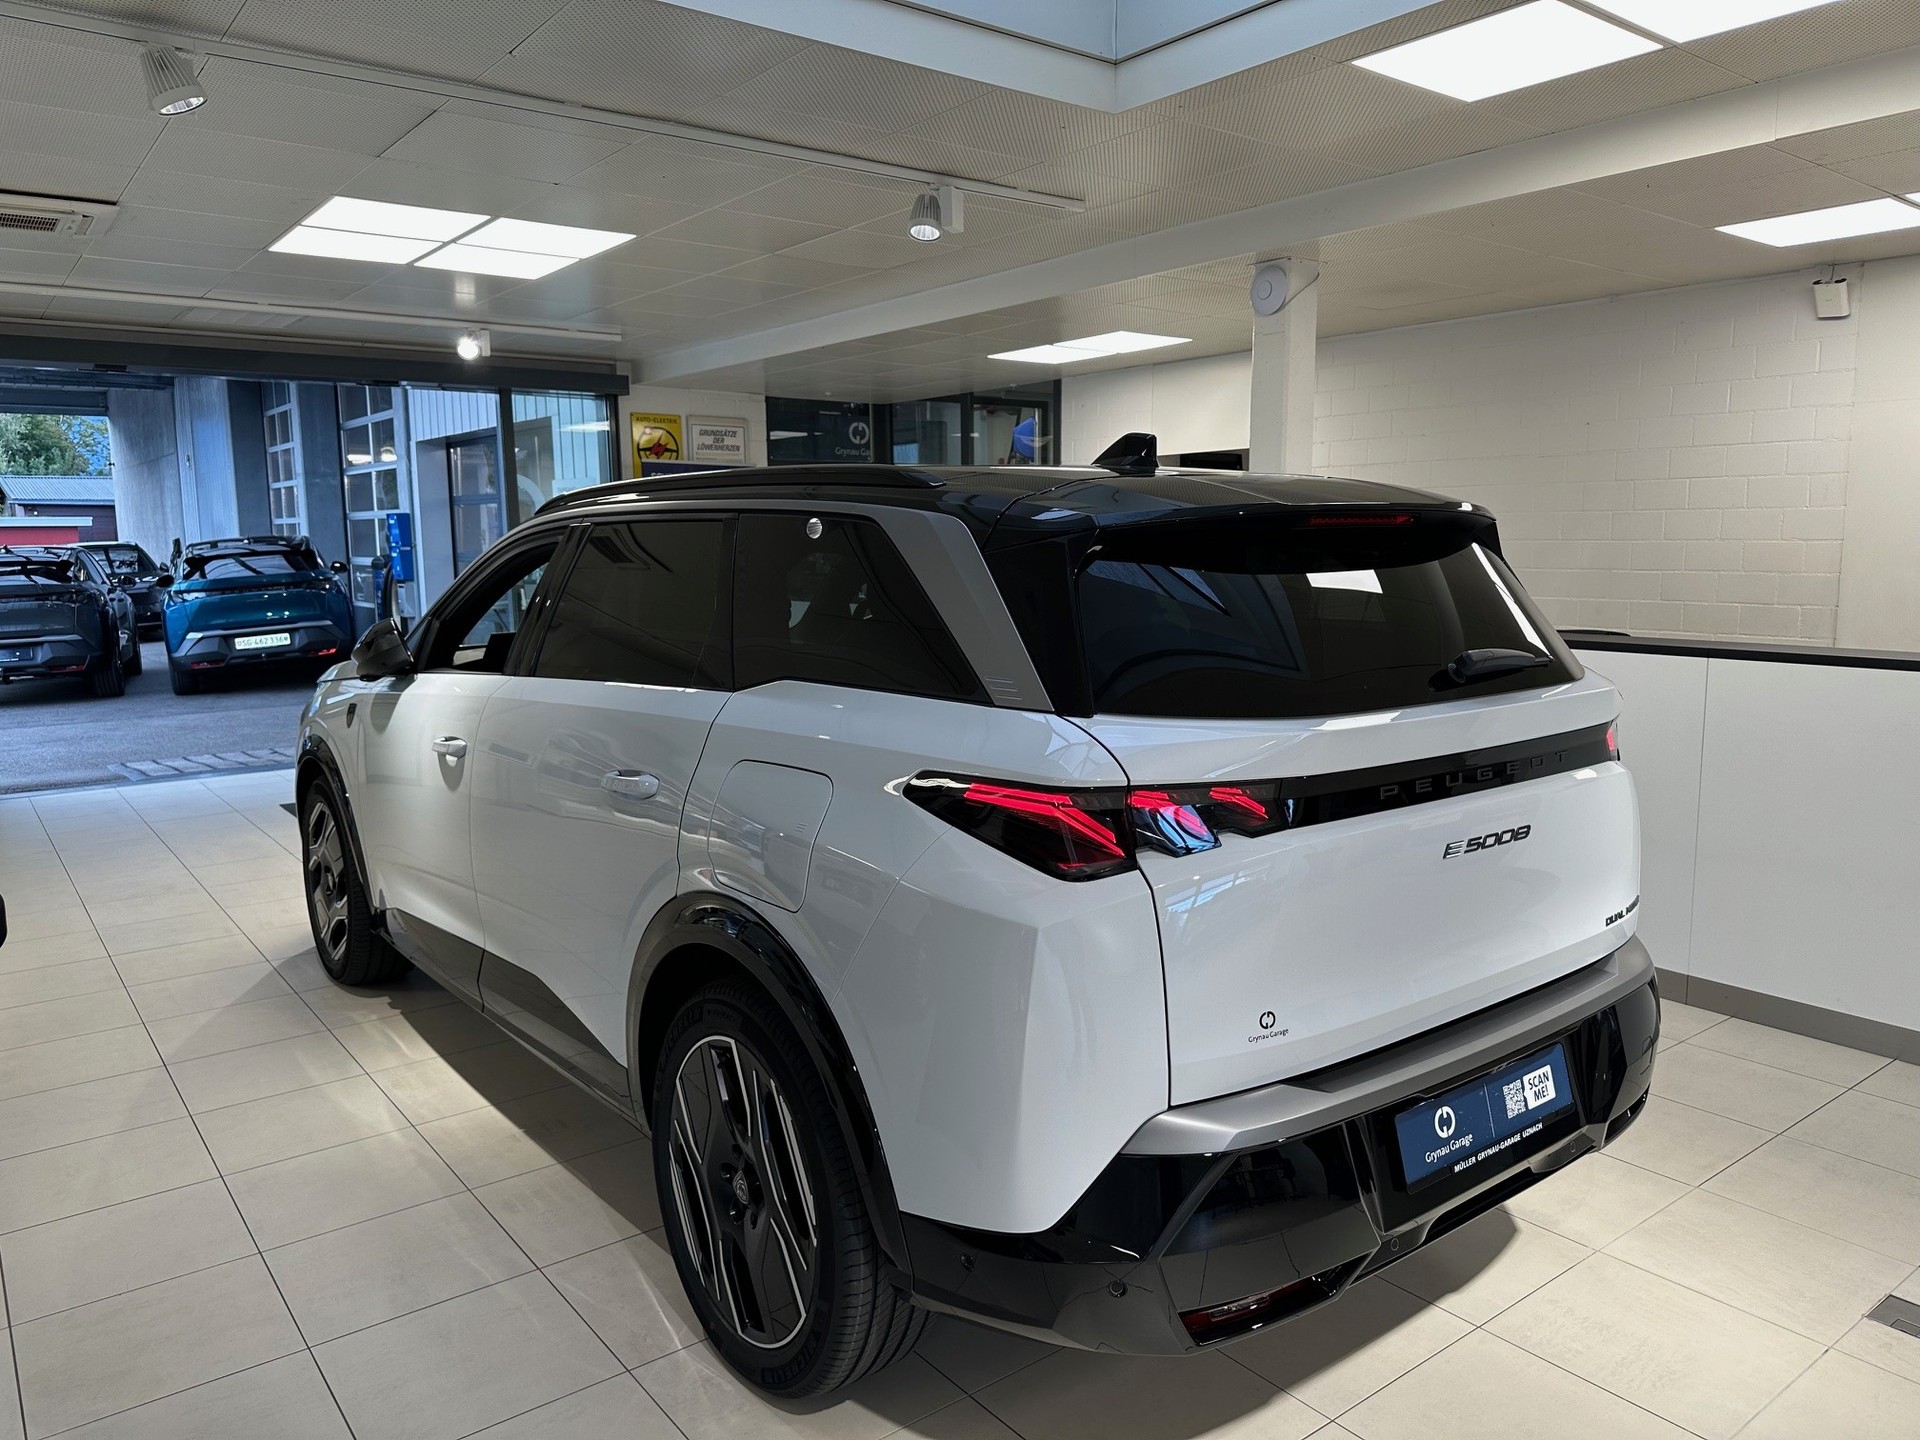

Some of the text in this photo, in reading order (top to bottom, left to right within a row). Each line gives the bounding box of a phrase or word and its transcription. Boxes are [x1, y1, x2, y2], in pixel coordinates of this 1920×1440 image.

[636, 416, 678, 424] AUTO-ELEKTRIK
[699, 428, 738, 438] GRUNDSÄTZE
[697, 443, 741, 452] LÖWENHERZEN
[835, 446, 859, 457] Grynau
[1380, 750, 1569, 800] PEUGEOT
[1605, 909, 1626, 927] DUAL
[1248, 1028, 1289, 1043] Grynau Garage
[1527, 1071, 1550, 1091] SCAN
[1533, 1084, 1550, 1103] ME!
[1425, 1132, 1473, 1164] Grynau Garage
[1454, 1121, 1543, 1173] MÜLLER GRYNAU-GARAGE UZNACH
